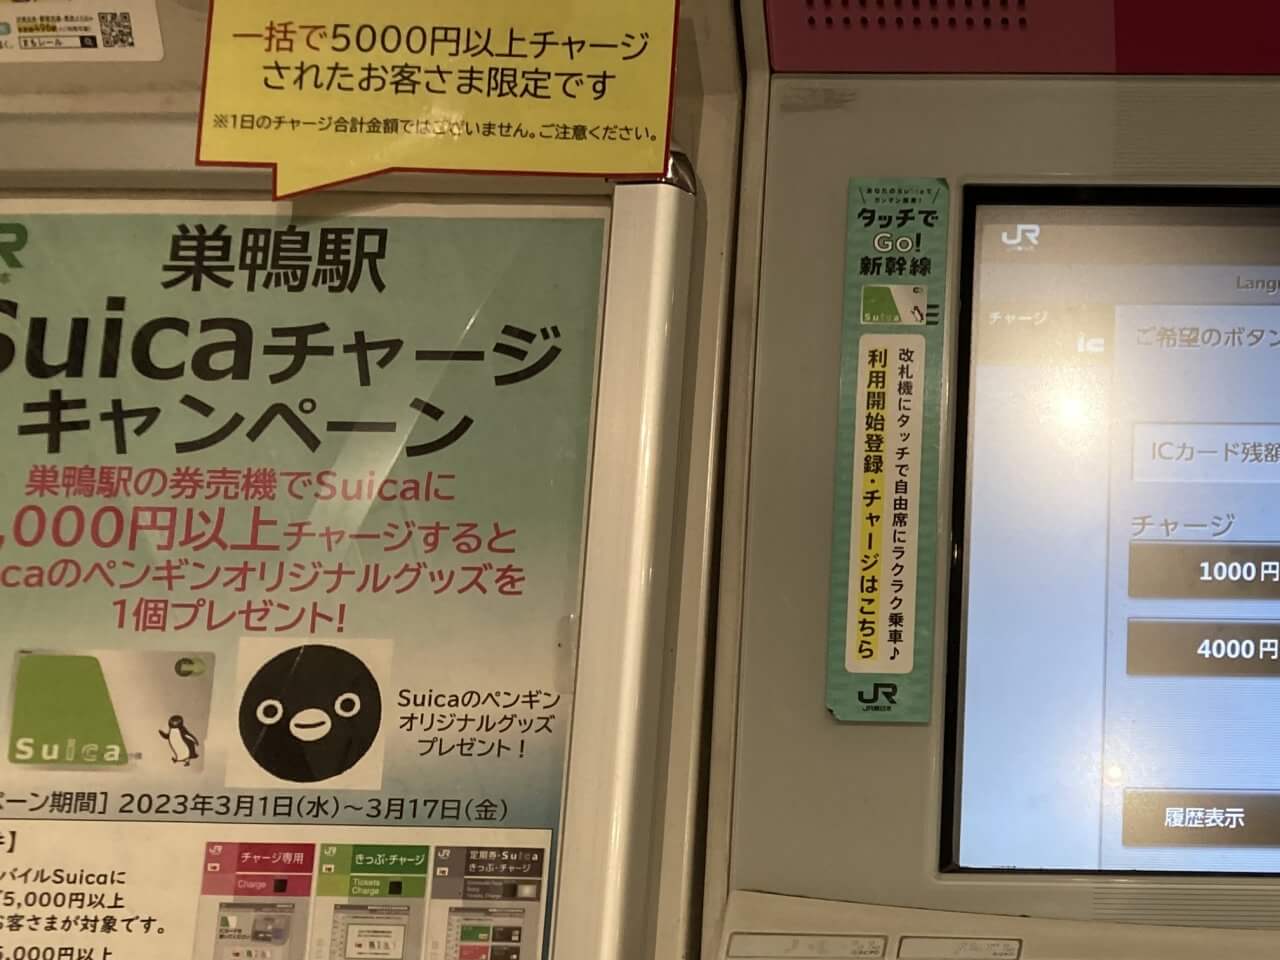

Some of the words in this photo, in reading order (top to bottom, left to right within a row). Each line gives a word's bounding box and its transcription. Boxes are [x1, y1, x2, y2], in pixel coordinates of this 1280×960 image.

[232, 22, 650, 61] 一括で5000円以上チャージ
[262, 63, 617, 101] されたお客さま限定です
[857, 208, 939, 228] タッチで
[873, 232, 921, 252] Go!
[1001, 223, 1040, 245] JR
[161, 222, 388, 293] 巣鴨駅
[859, 256, 931, 276] 新幹線
[0, 297, 562, 388] uicaチャージ
[17, 388, 474, 456] キャンペーン
[25, 464, 456, 502] 巣鴨駅の券売機でSuicaに
[1130, 513, 1236, 537] チャージ
[1199, 561, 1280, 583] 1000円
[113, 597, 346, 633] 1個プレゼント!
[1197, 638, 1279, 660] 4000円
[397, 688, 561, 709] Suicaのペンギン
[858, 682, 898, 704] JR
[398, 712, 556, 735] オリジナルグッズ
[15, 738, 121, 762] Suica
[417, 737, 526, 759] プレゼント！
[0, 790, 108, 815] ーン期間]
[1164, 806, 1245, 828] 履歴表示
[241, 852, 304, 865] チャージ専用
[0, 890, 125, 910] 5,000円以上
[0, 914, 165, 935] 客さまが対象です。
